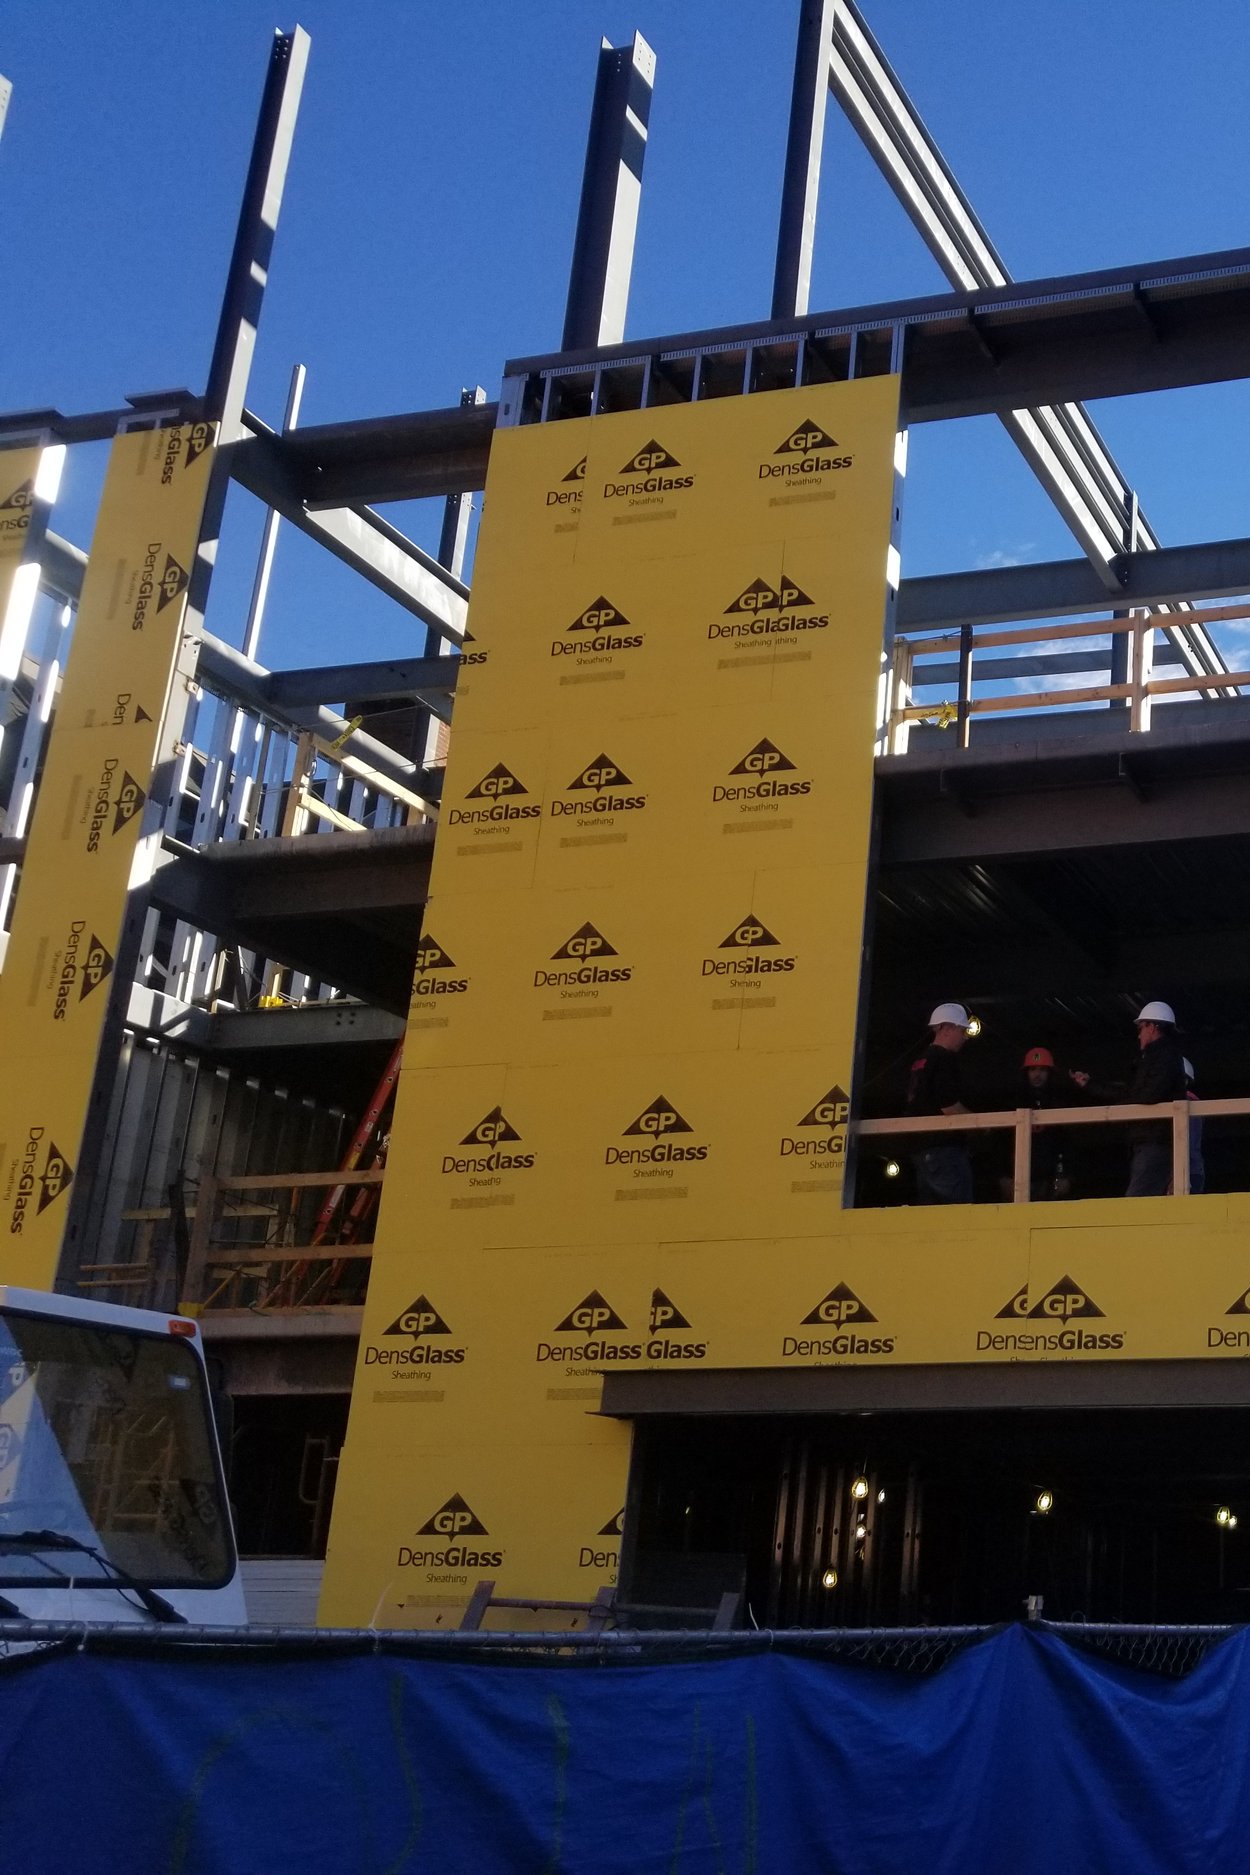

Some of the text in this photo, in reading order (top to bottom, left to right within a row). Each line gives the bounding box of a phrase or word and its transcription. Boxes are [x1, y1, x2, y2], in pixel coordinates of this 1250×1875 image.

[192, 423, 208, 453] GP
[788, 431, 823, 449] GP
[633, 451, 667, 469] GP
[759, 454, 853, 479] DensGlass
[603, 475, 694, 499] DensGlass
[785, 477, 822, 488] Sheathing
[628, 496, 664, 507] Sheathing
[132, 542, 163, 631] DensGlass
[165, 566, 181, 598] GP
[581, 609, 616, 627] GP
[551, 634, 644, 657] DensGlass
[575, 655, 612, 666] Sheathing
[744, 752, 781, 771] GP
[480, 776, 514, 795] GP
[582, 767, 617, 786] GP
[119, 783, 139, 818] GP
[712, 779, 811, 802] DensGlass
[87, 758, 119, 853] DensGlass
[449, 803, 541, 825] DensGlass
[550, 794, 646, 817] DensGlass
[740, 803, 779, 813] Sheathing
[473, 825, 510, 836] Sheathing
[576, 816, 614, 827] Sheathing
[567, 937, 603, 956] GP
[54, 920, 87, 1021] DensGlass
[86, 947, 105, 984] GP
[533, 965, 632, 987] DensGlass
[560, 989, 599, 1000] Sheathing
[639, 1112, 677, 1132] GP
[814, 1102, 849, 1123] GP
[605, 1143, 708, 1165] DensGlass
[10, 1127, 45, 1234] DensGlass
[45, 1157, 65, 1197] GP
[632, 1167, 674, 1179] Sheathing
[818, 1300, 859, 1321] GP
[1043, 1294, 1086, 1315] GP
[399, 1312, 436, 1332] GP
[571, 1307, 611, 1328] GP
[364, 1345, 465, 1365] DensGlass
[536, 1341, 642, 1362] DensGlass
[783, 1334, 895, 1357] DensGlass
[391, 1369, 431, 1380] Sheathing
[433, 1511, 472, 1533] GP
[397, 1547, 503, 1567] DensGlass
[426, 1573, 467, 1585] Sheathing
